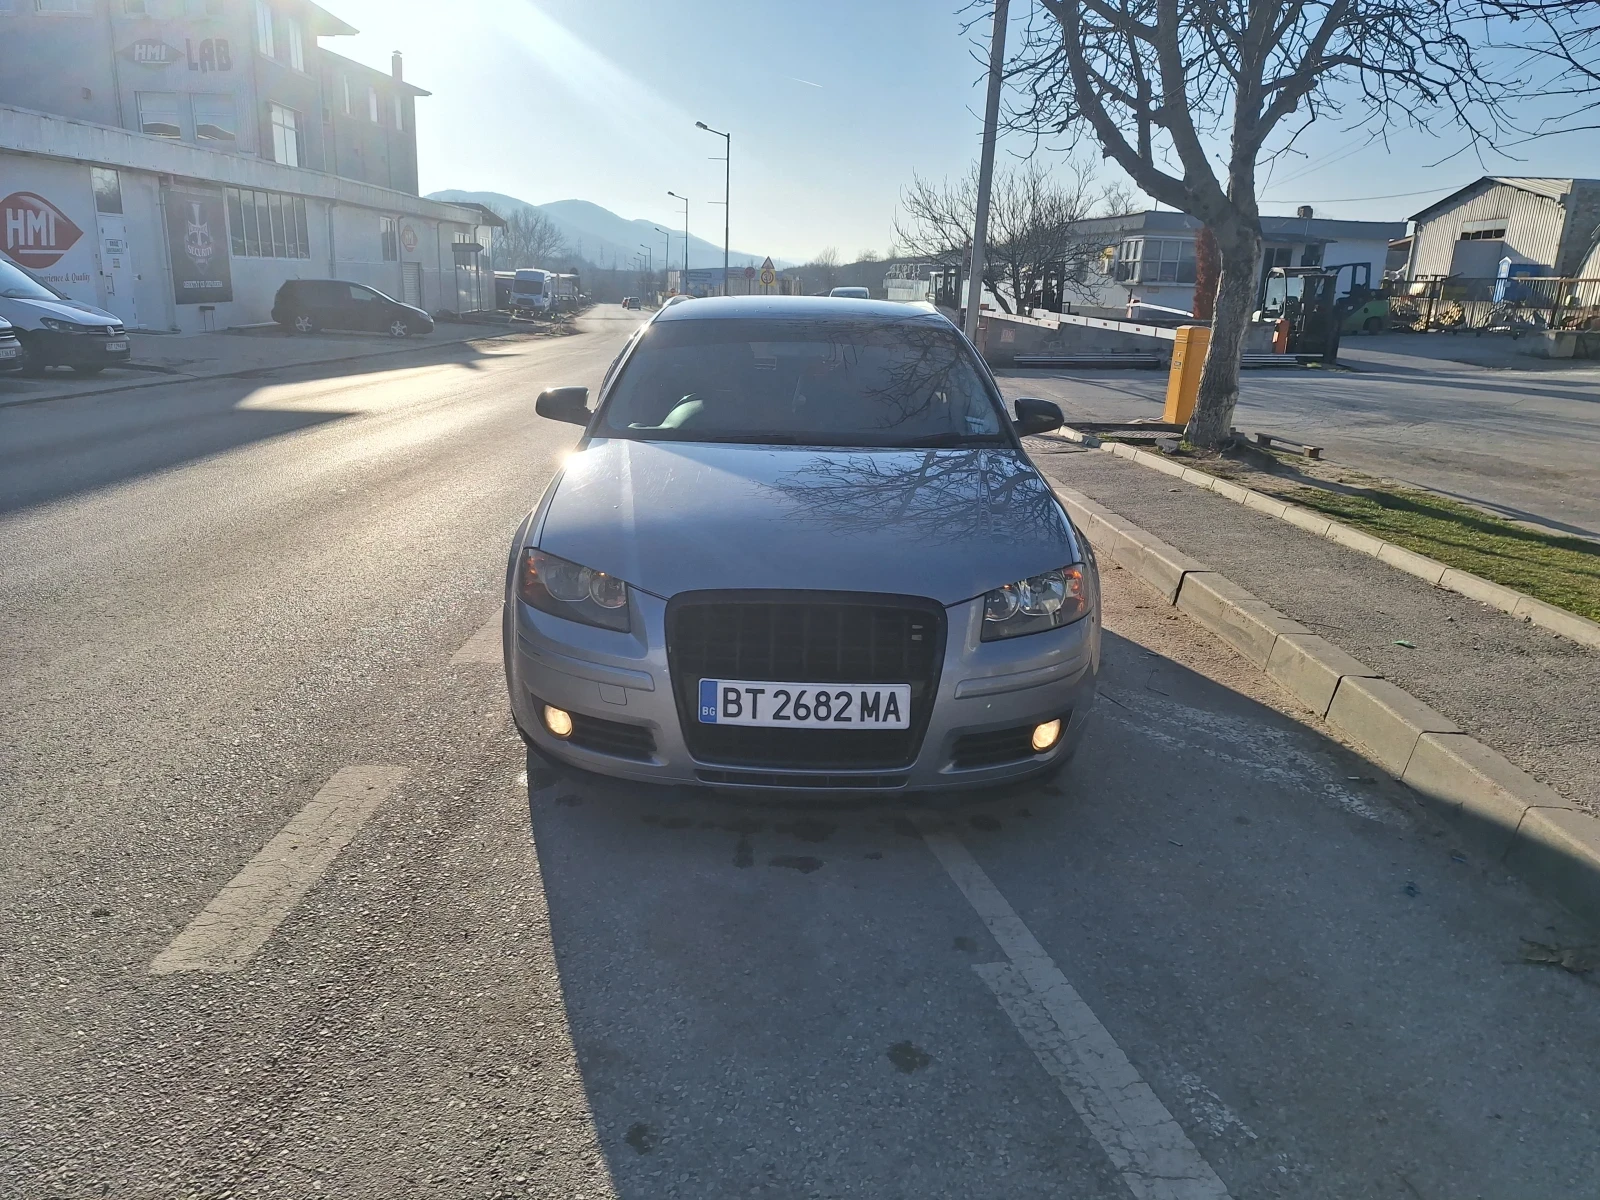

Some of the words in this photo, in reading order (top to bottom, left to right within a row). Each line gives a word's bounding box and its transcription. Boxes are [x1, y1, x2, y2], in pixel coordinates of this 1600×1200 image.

[134, 44, 166, 61] HMI
[185, 38, 232, 74] LAB
[6, 207, 56, 250] HMI
[187, 245, 212, 257] SECURITY
[64, 273, 70, 281] &
[71, 272, 91, 284] Quality
[702, 706, 716, 716] BG
[722, 687, 765, 719] BT
[772, 690, 852, 722] 2682
[859, 691, 901, 722] MA
